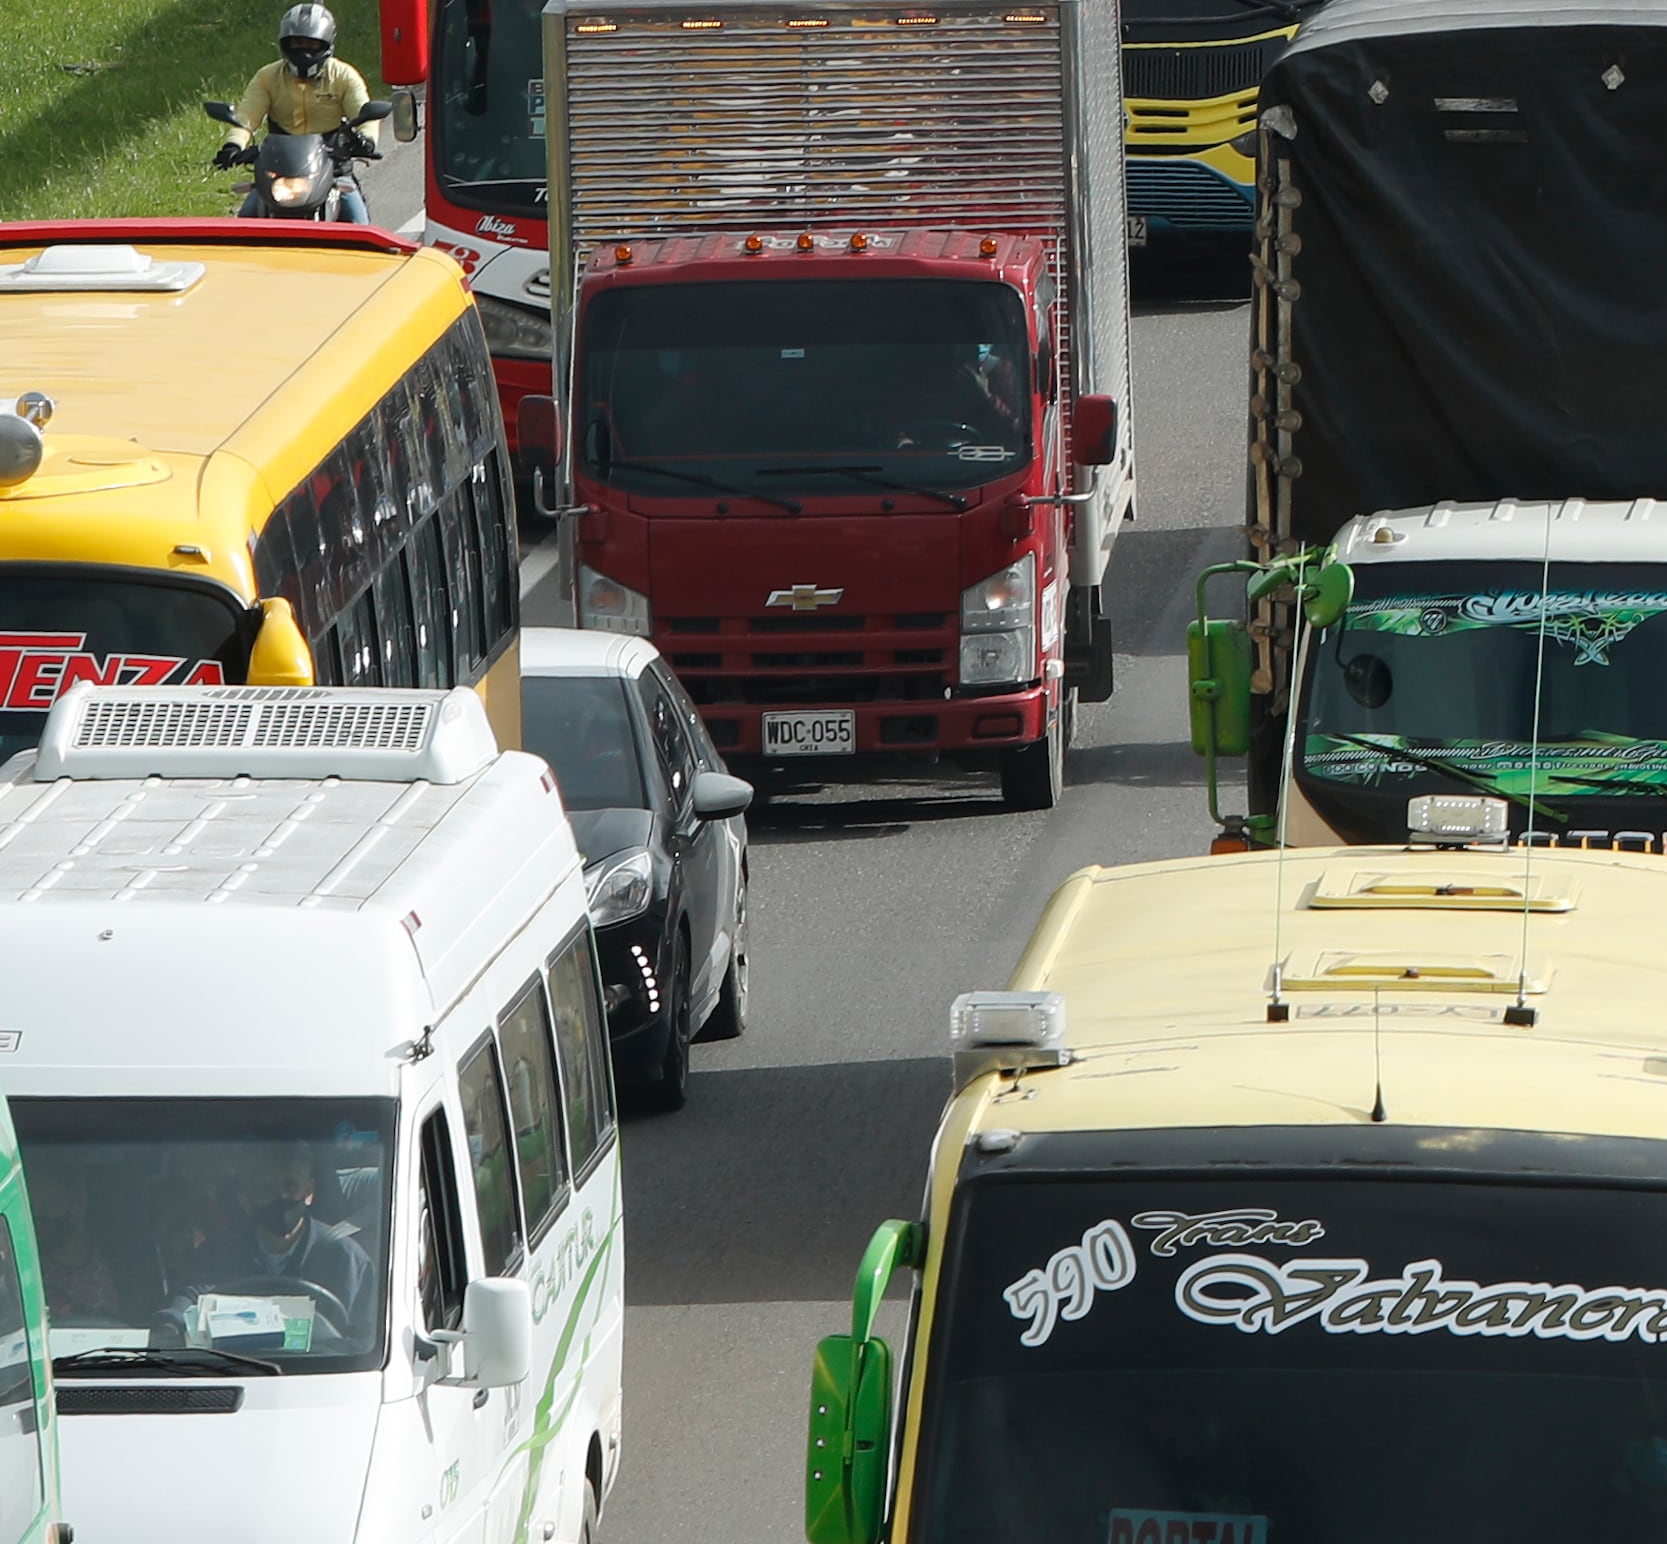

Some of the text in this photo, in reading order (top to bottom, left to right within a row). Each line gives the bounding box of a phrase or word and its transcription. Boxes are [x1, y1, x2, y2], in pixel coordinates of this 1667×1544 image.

[475, 214, 517, 235] Ibiza
[1131, 1208, 1325, 1256] Trans
[1002, 1218, 1136, 1346] 590
